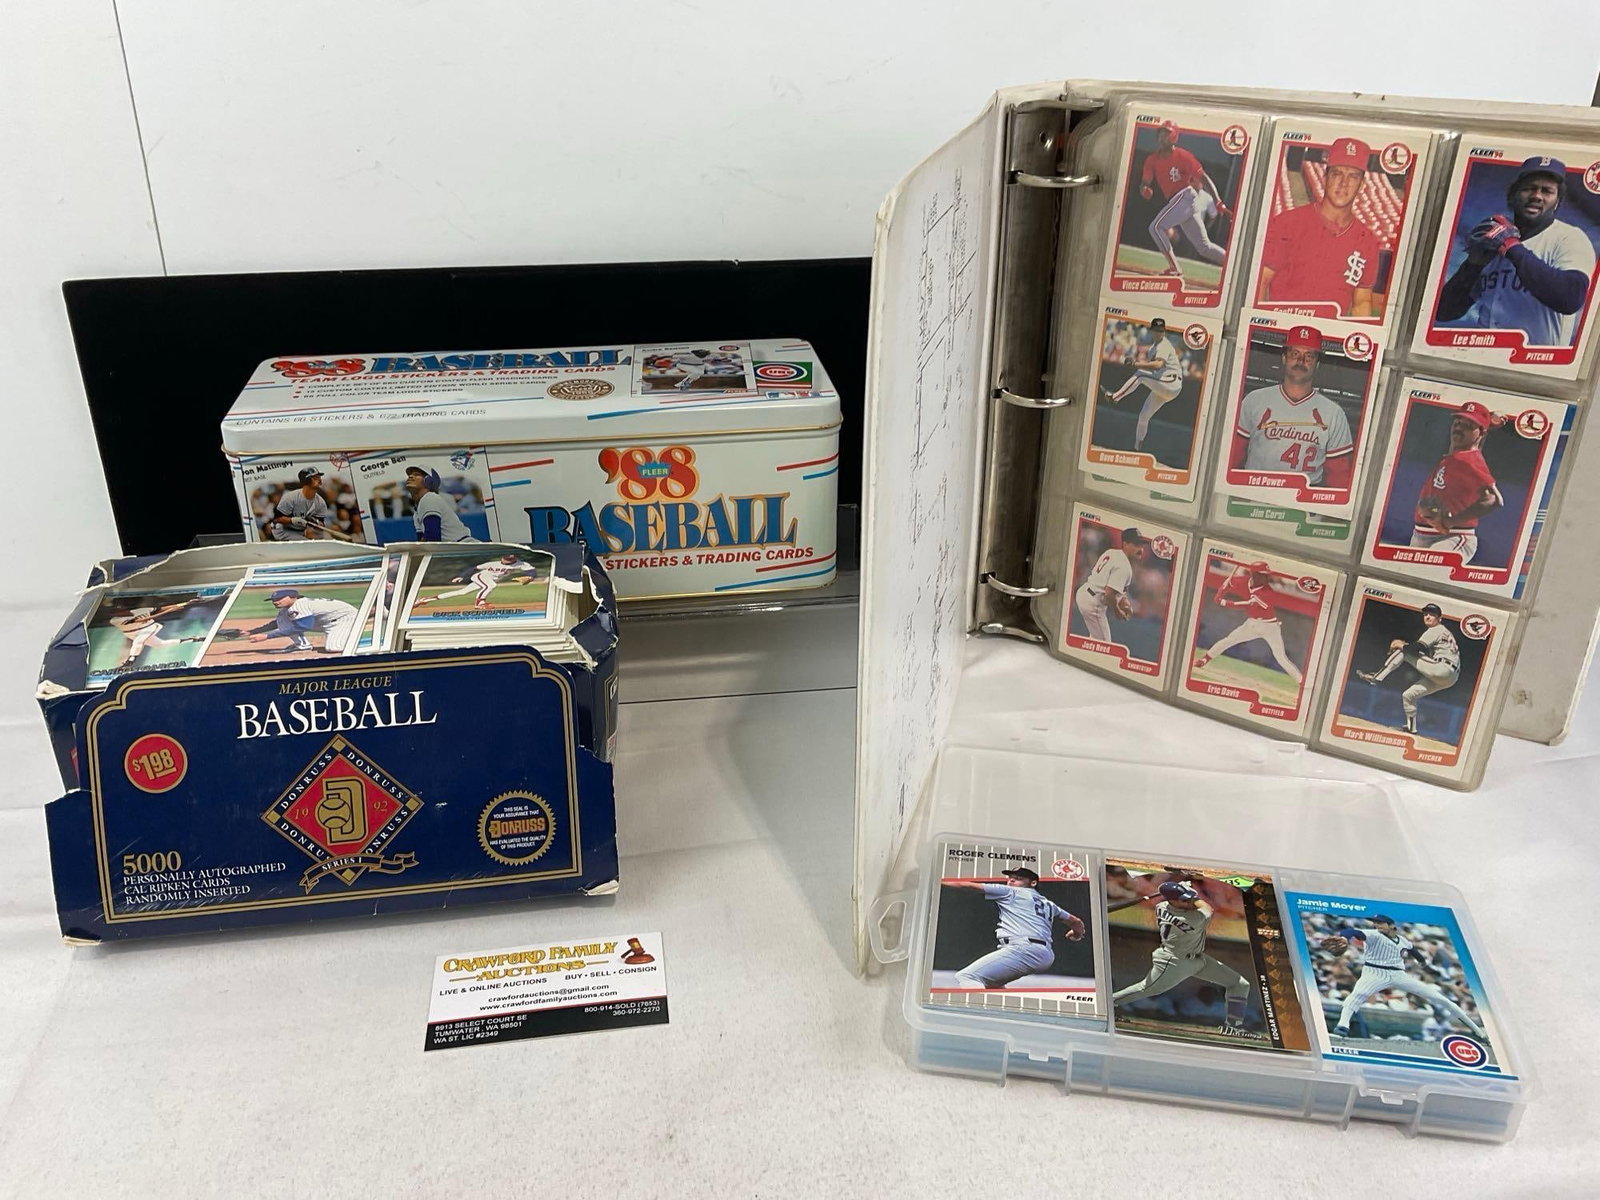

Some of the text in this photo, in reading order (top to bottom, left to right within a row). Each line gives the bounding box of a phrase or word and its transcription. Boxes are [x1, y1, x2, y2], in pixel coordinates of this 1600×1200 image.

[1122, 279, 1169, 291] Vince Coleman
[1184, 296, 1208, 304] OUTFIELD
[1452, 333, 1496, 346] Lee Smith
[364, 349, 632, 374] BASEBALL
[1525, 352, 1554, 361] PITCHER
[290, 376, 338, 384] TEAM
[390, 371, 462, 379] STICKERS
[236, 417, 290, 425] CONTAINS
[1264, 425, 1320, 446] Cardinals
[1280, 442, 1318, 473] 42
[256, 460, 294, 473] Mattingly
[360, 460, 390, 472] George
[641, 467, 669, 477] FLEER
[1248, 475, 1286, 487] Ted Power
[1312, 492, 1336, 501] PITCHER
[1250, 506, 1264, 517] Jim
[523, 492, 798, 556] BASEBALL
[1312, 528, 1336, 537] PITCHER
[604, 547, 814, 571] STICKERS & TRADING CARDS
[1393, 550, 1444, 564] Jose DeLeon
[1467, 572, 1494, 581] PITCHER
[279, 675, 393, 696] MAJOR LEAGUE
[1207, 684, 1240, 698] Eric Davis
[235, 690, 438, 740] BASEBALL
[1261, 707, 1285, 717] OUTFIELD
[1344, 728, 1407, 747] Mark Williamson
[1417, 753, 1442, 763] PITCHER
[281, 753, 332, 810] DONRUSS
[347, 752, 404, 800] DONRUSS
[365, 809, 408, 856] ONRUSS
[489, 817, 546, 839] DONRUSS
[280, 822, 332, 861] DONRU
[949, 849, 1037, 862] ROGER CLEMENS
[123, 850, 182, 876] 5000
[321, 857, 356, 871] SERIES
[123, 862, 287, 886] PERSONALLY AUTOGRAPHED
[124, 877, 231, 896] CAL RIPKEN CARDS
[125, 885, 251, 905] RANDOMLY INSERTED
[1296, 898, 1367, 912] Jamie Moyer
[443, 941, 618, 973] CRAWFORD FAMILY
[475, 959, 586, 982] AUCTIONS
[565, 966, 657, 981] BUY SELL CONSIGN
[439, 988, 459, 996] LIVE
[469, 983, 501, 992] ONLINE
[503, 977, 548, 988] AUCTIONS
[488, 984, 610, 1003] crawfordauctions@gmail.com
[479, 990, 618, 1011] www.crawfordfamilyauctions.com
[1066, 994, 1093, 1003] FLEER
[1261, 986, 1280, 1040] EDGAR MARTINEZ
[455, 1020, 485, 1029] SELECT
[487, 1015, 515, 1025] COURT
[500, 1021, 522, 1029] 98501
[461, 1032, 474, 1040] LIC
[1333, 1047, 1359, 1056] FLEER
